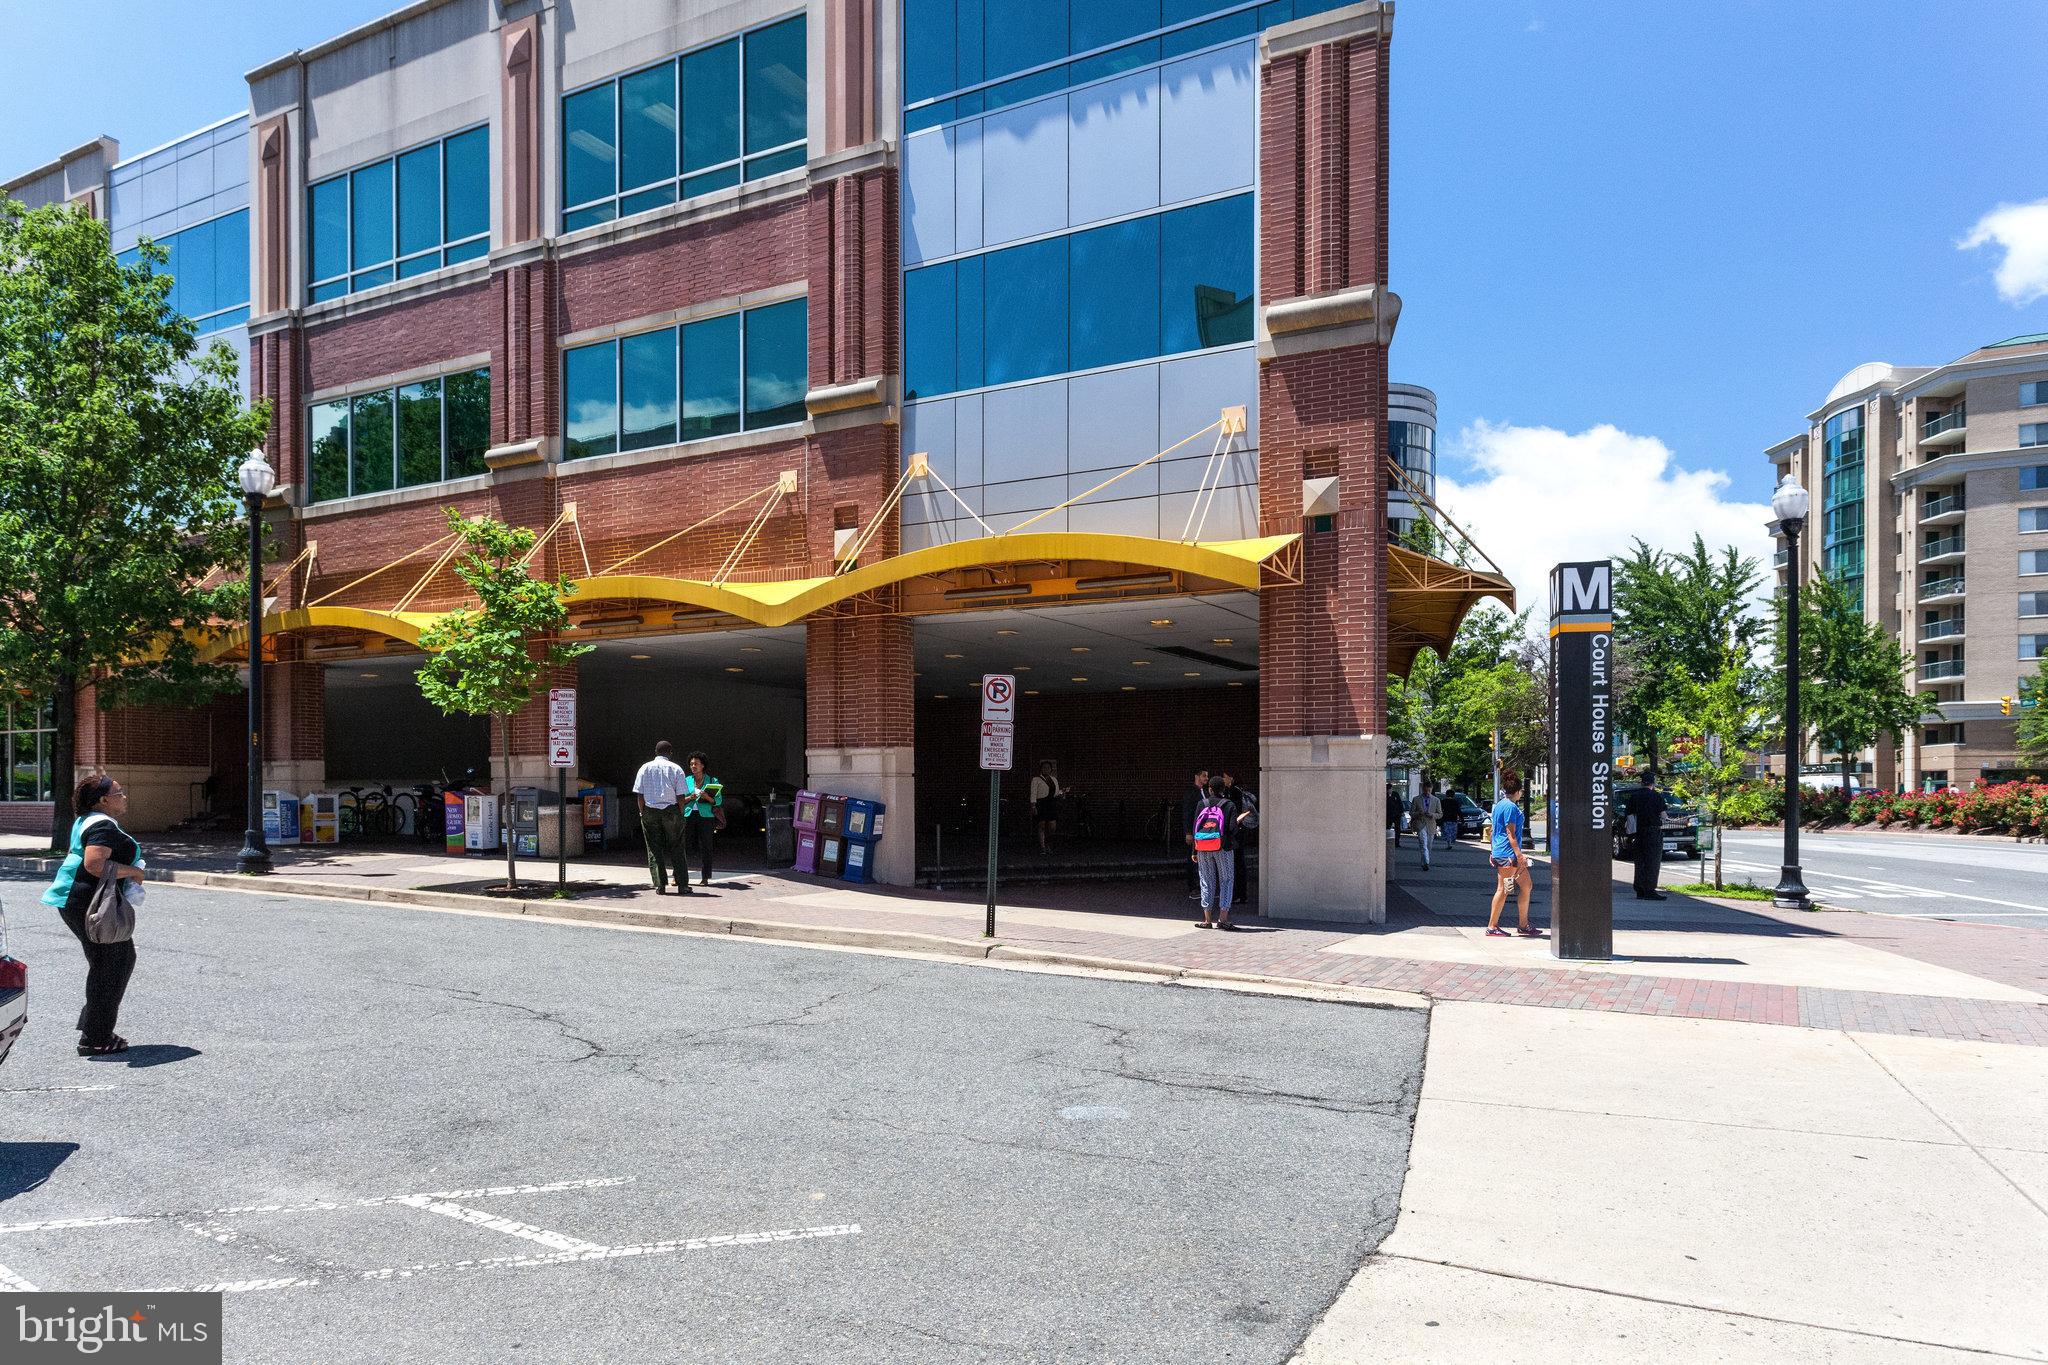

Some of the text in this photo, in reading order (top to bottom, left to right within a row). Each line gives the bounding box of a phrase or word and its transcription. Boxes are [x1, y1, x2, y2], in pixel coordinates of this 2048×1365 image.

[1550, 570, 1560, 617] M
[1563, 566, 1609, 610] M
[551, 691, 558, 700] NO
[984, 724, 1012, 734] NO PARKING
[1592, 634, 1610, 830] Court House Station
